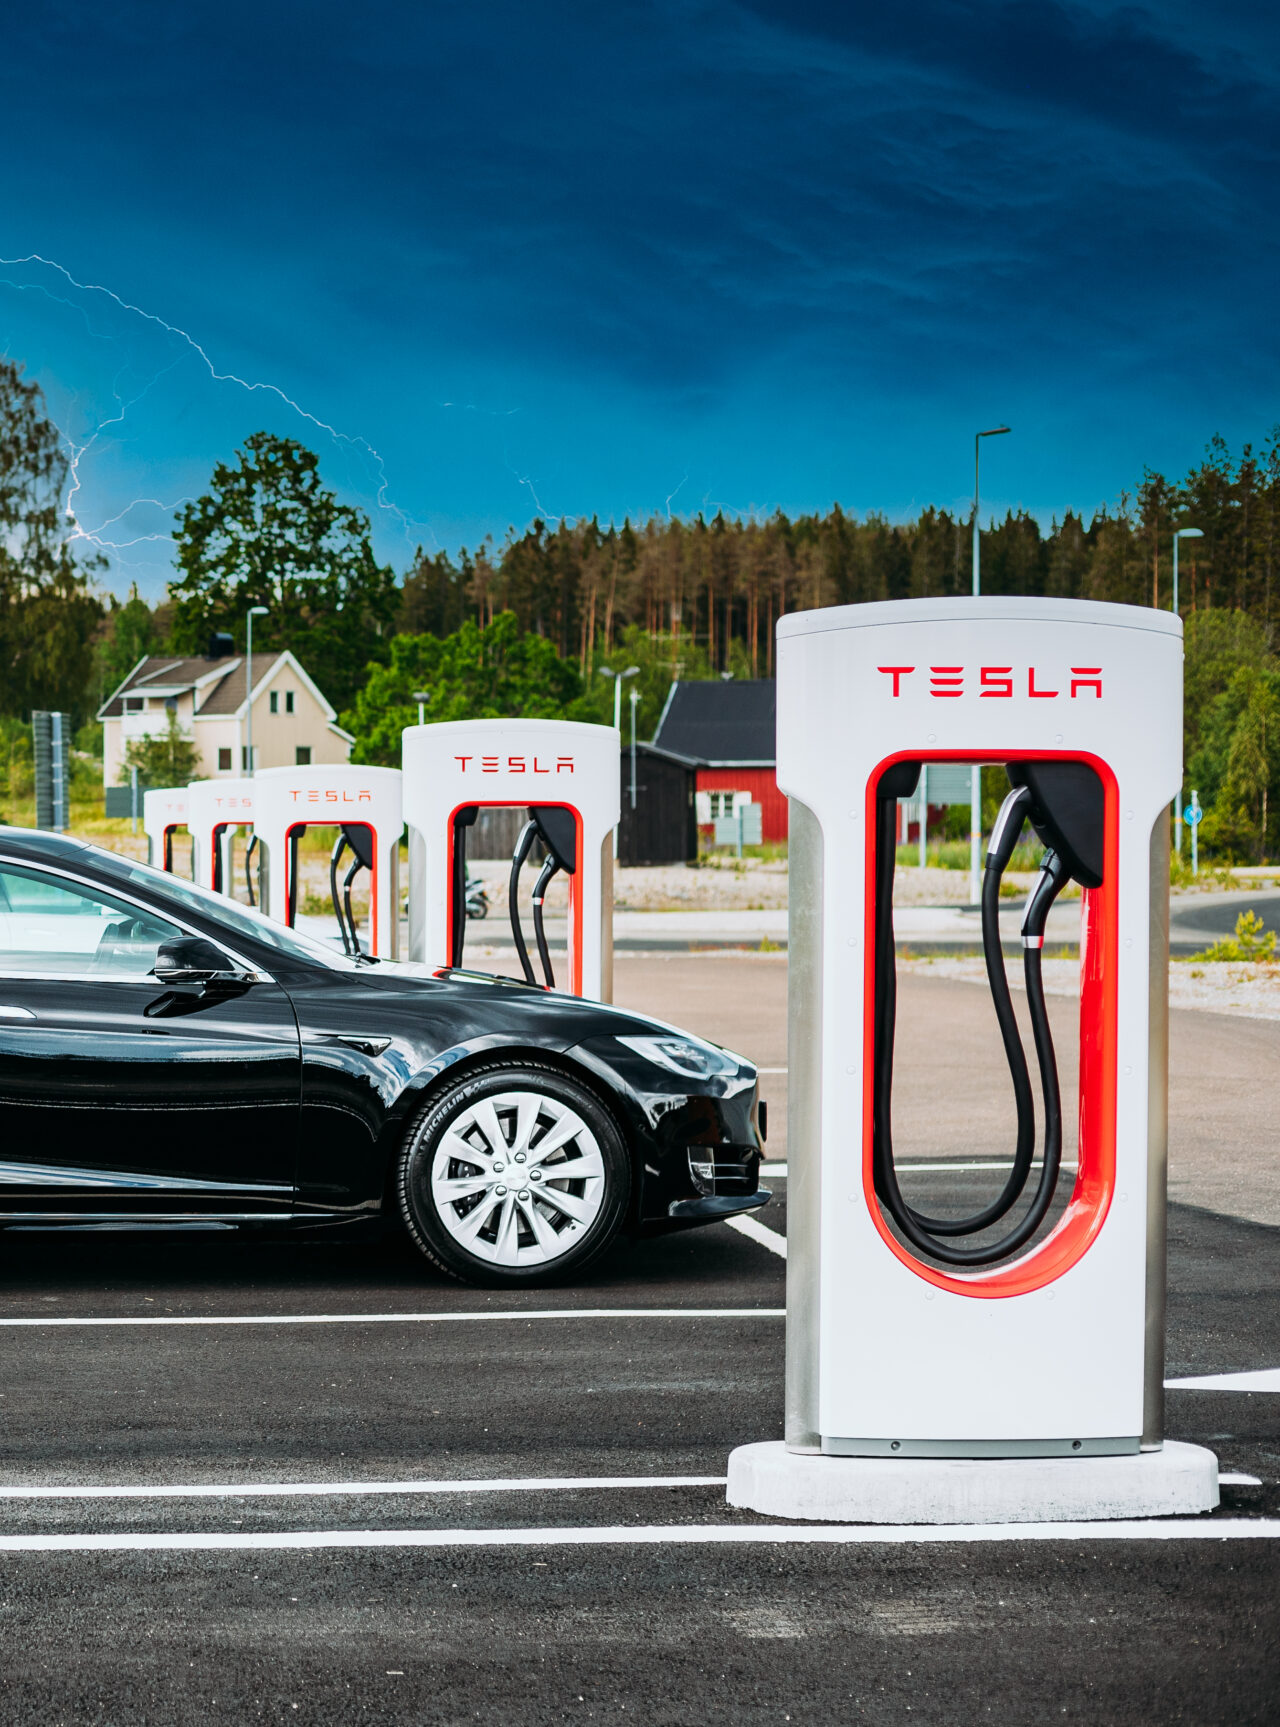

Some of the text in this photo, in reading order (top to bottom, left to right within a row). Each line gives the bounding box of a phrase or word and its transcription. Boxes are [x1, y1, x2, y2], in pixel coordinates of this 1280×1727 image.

[877, 666, 1103, 698] TESLA
[454, 756, 574, 773] TESLA
[215, 797, 252, 808] TES
[289, 790, 372, 802] TESLA
[423, 1092, 465, 1142] MICHELIN
